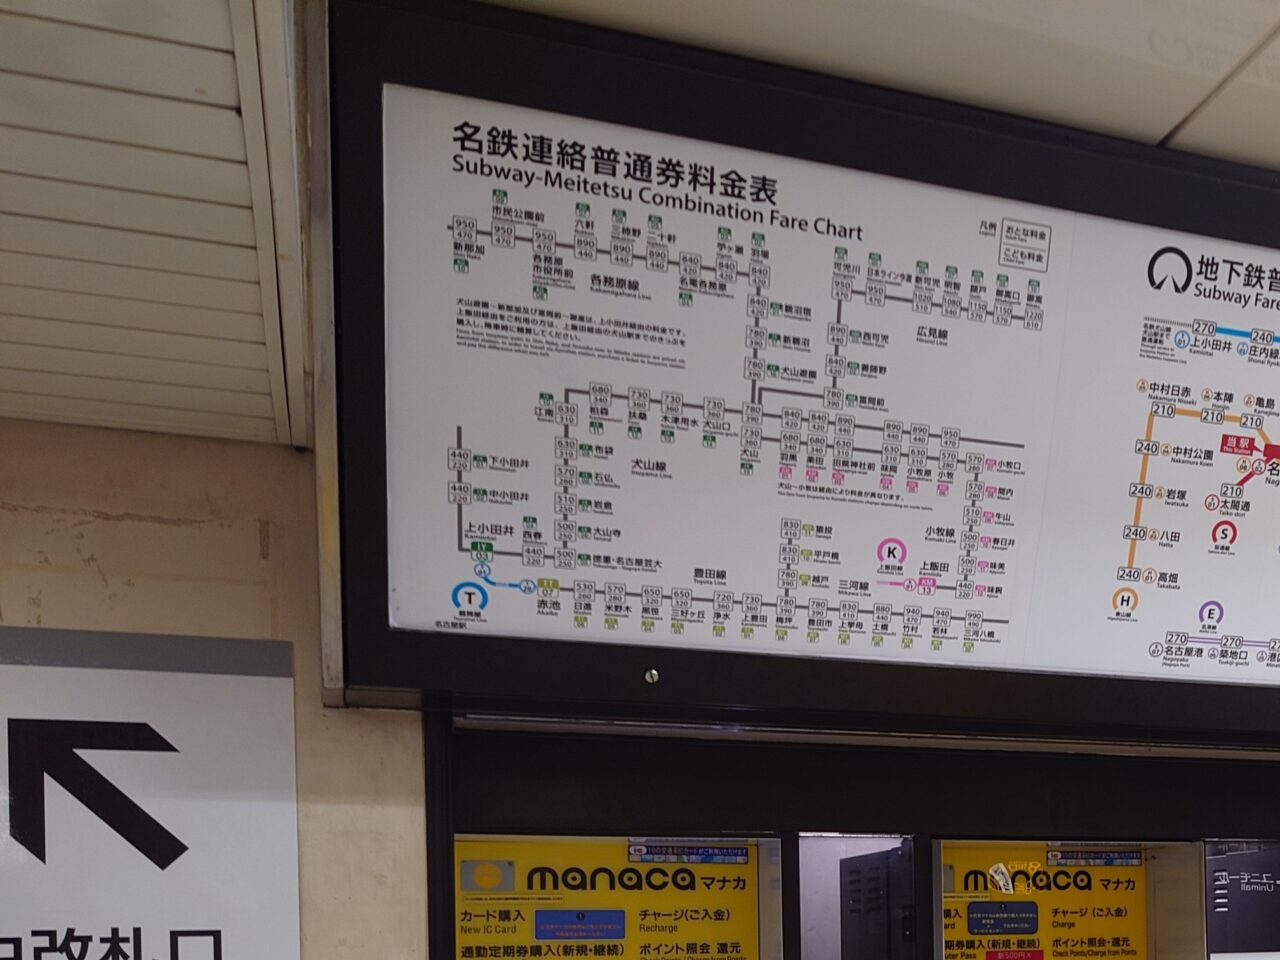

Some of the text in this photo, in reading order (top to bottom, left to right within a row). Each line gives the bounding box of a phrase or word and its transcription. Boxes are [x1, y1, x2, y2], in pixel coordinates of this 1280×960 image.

[452, 121, 778, 206] 名鉄連絡普通券料金表
[452, 154, 863, 242] Subway-Meitetsu Combination Fare Chart
[456, 219, 474, 230] 950
[1005, 225, 1047, 241] おとな料金
[1003, 248, 1044, 264] こども料金
[590, 273, 640, 291] 各務原線
[1193, 282, 1251, 308] Subway
[917, 326, 949, 341] 広見線
[1194, 322, 1216, 335] 270
[1252, 331, 1273, 344] 240
[1190, 337, 1233, 353] 上小田井
[1148, 382, 1192, 398] 中村日赤
[1213, 391, 1235, 404] 本陣
[1255, 396, 1276, 409] 亀島
[1153, 404, 1175, 417] 210
[1137, 441, 1159, 454] 240
[1226, 436, 1251, 450] 当駅
[1172, 446, 1214, 461] 中村公園
[631, 458, 667, 472] 犬山線
[1165, 487, 1188, 501] 岩塚
[1219, 497, 1251, 512] 太閤通
[464, 521, 515, 537] 上小田井
[925, 526, 955, 539] 小牧線
[1159, 530, 1181, 543] 八田
[694, 567, 727, 581] 豊田線
[919, 561, 950, 573] 上飯田
[839, 579, 869, 592] 三河線
[1157, 572, 1179, 585] 高畑
[537, 600, 561, 611] 赤池
[1164, 645, 1204, 659] 名古屋港
[1218, 648, 1249, 661] 築地口
[527, 866, 746, 891] manaca マナカ
[1100, 878, 1136, 891] マナカ
[460, 909, 526, 923] カード購入
[639, 908, 731, 922] チャージ(ご入金)
[460, 924, 517, 935] New Card
[639, 924, 678, 934] Recharge
[461, 943, 626, 959] 通勤定期券購入(新規・継続)
[639, 942, 742, 956] ポイント照会 還元
